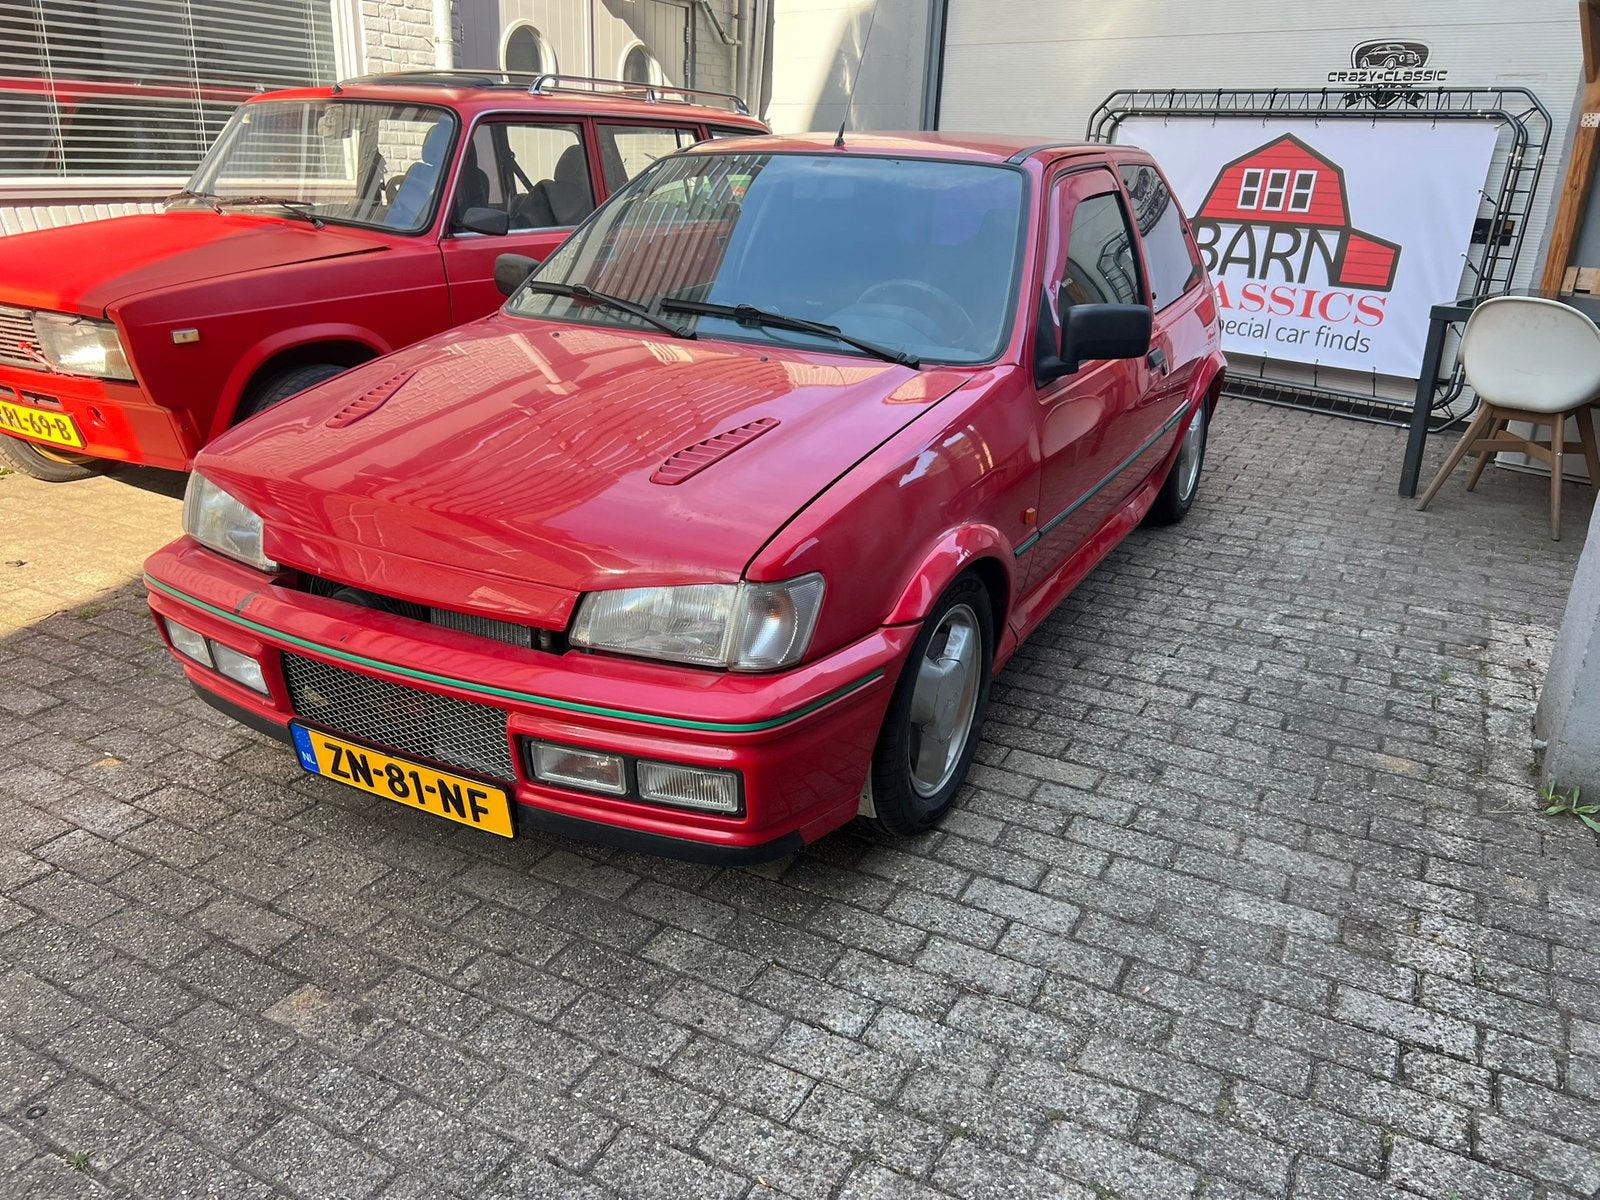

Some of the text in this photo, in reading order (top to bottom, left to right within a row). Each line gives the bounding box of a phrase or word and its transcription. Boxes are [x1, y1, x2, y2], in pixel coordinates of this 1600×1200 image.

[1197, 222, 1349, 287] BARN
[1213, 280, 1388, 328] ASSICS
[1220, 316, 1372, 354] ecial car finds
[301, 750, 316, 765] NL
[323, 741, 489, 823] ZN-81-NF
